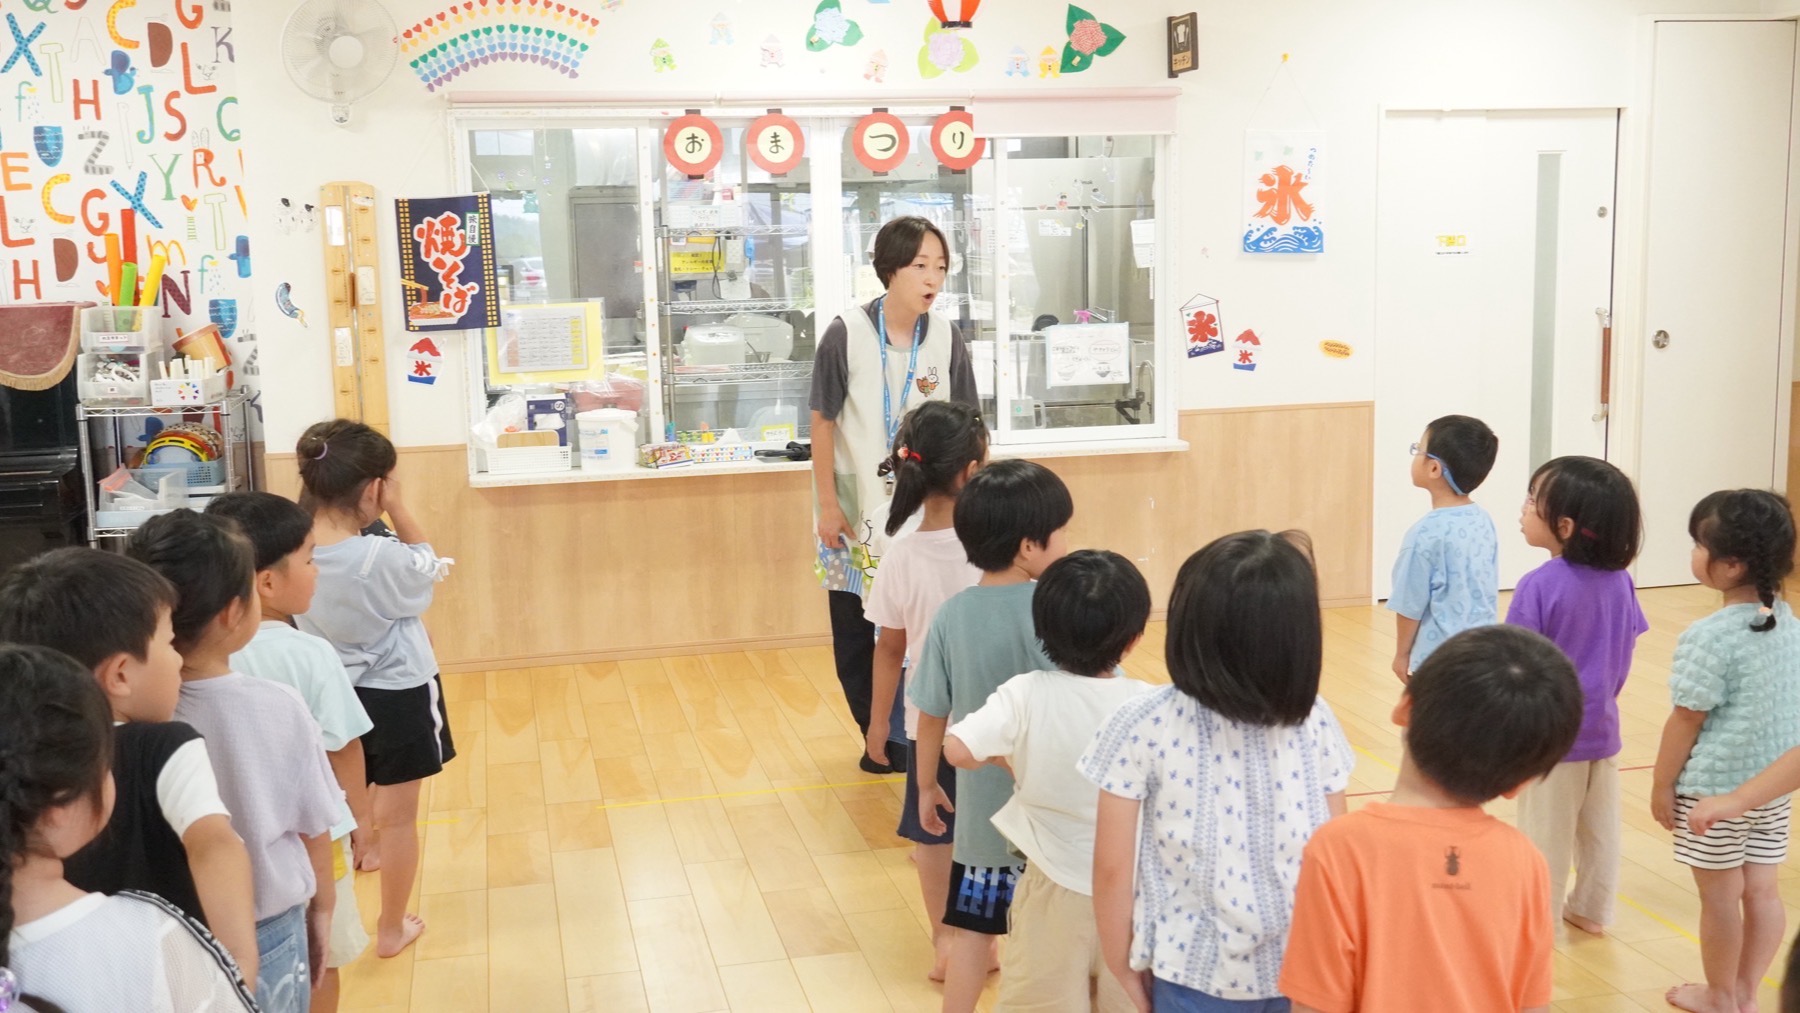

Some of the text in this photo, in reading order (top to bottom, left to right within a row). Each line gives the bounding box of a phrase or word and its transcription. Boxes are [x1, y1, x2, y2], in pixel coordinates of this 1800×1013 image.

[0, 12, 47, 76] X
[211, 26, 235, 63] K
[181, 42, 217, 94] L
[73, 79, 101, 120] H
[137, 85, 154, 144] J
[164, 91, 187, 141] S
[78, 131, 114, 175] Z
[685, 130, 965, 154] お ま つ り
[0, 152, 33, 191] E
[148, 153, 183, 201] Y
[193, 148, 227, 189] R
[42, 174, 75, 224] C
[81, 189, 110, 236] G
[110, 171, 164, 229] X
[1253, 164, 1315, 225] 氷
[0, 195, 35, 247] L
[13, 259, 42, 300] H
[414, 212, 478, 315] 焼そば
[162, 270, 192, 318] N
[1186, 310, 1219, 343] 氷
[412, 359, 432, 377] 氷
[1237, 349, 1254, 364] 氷
